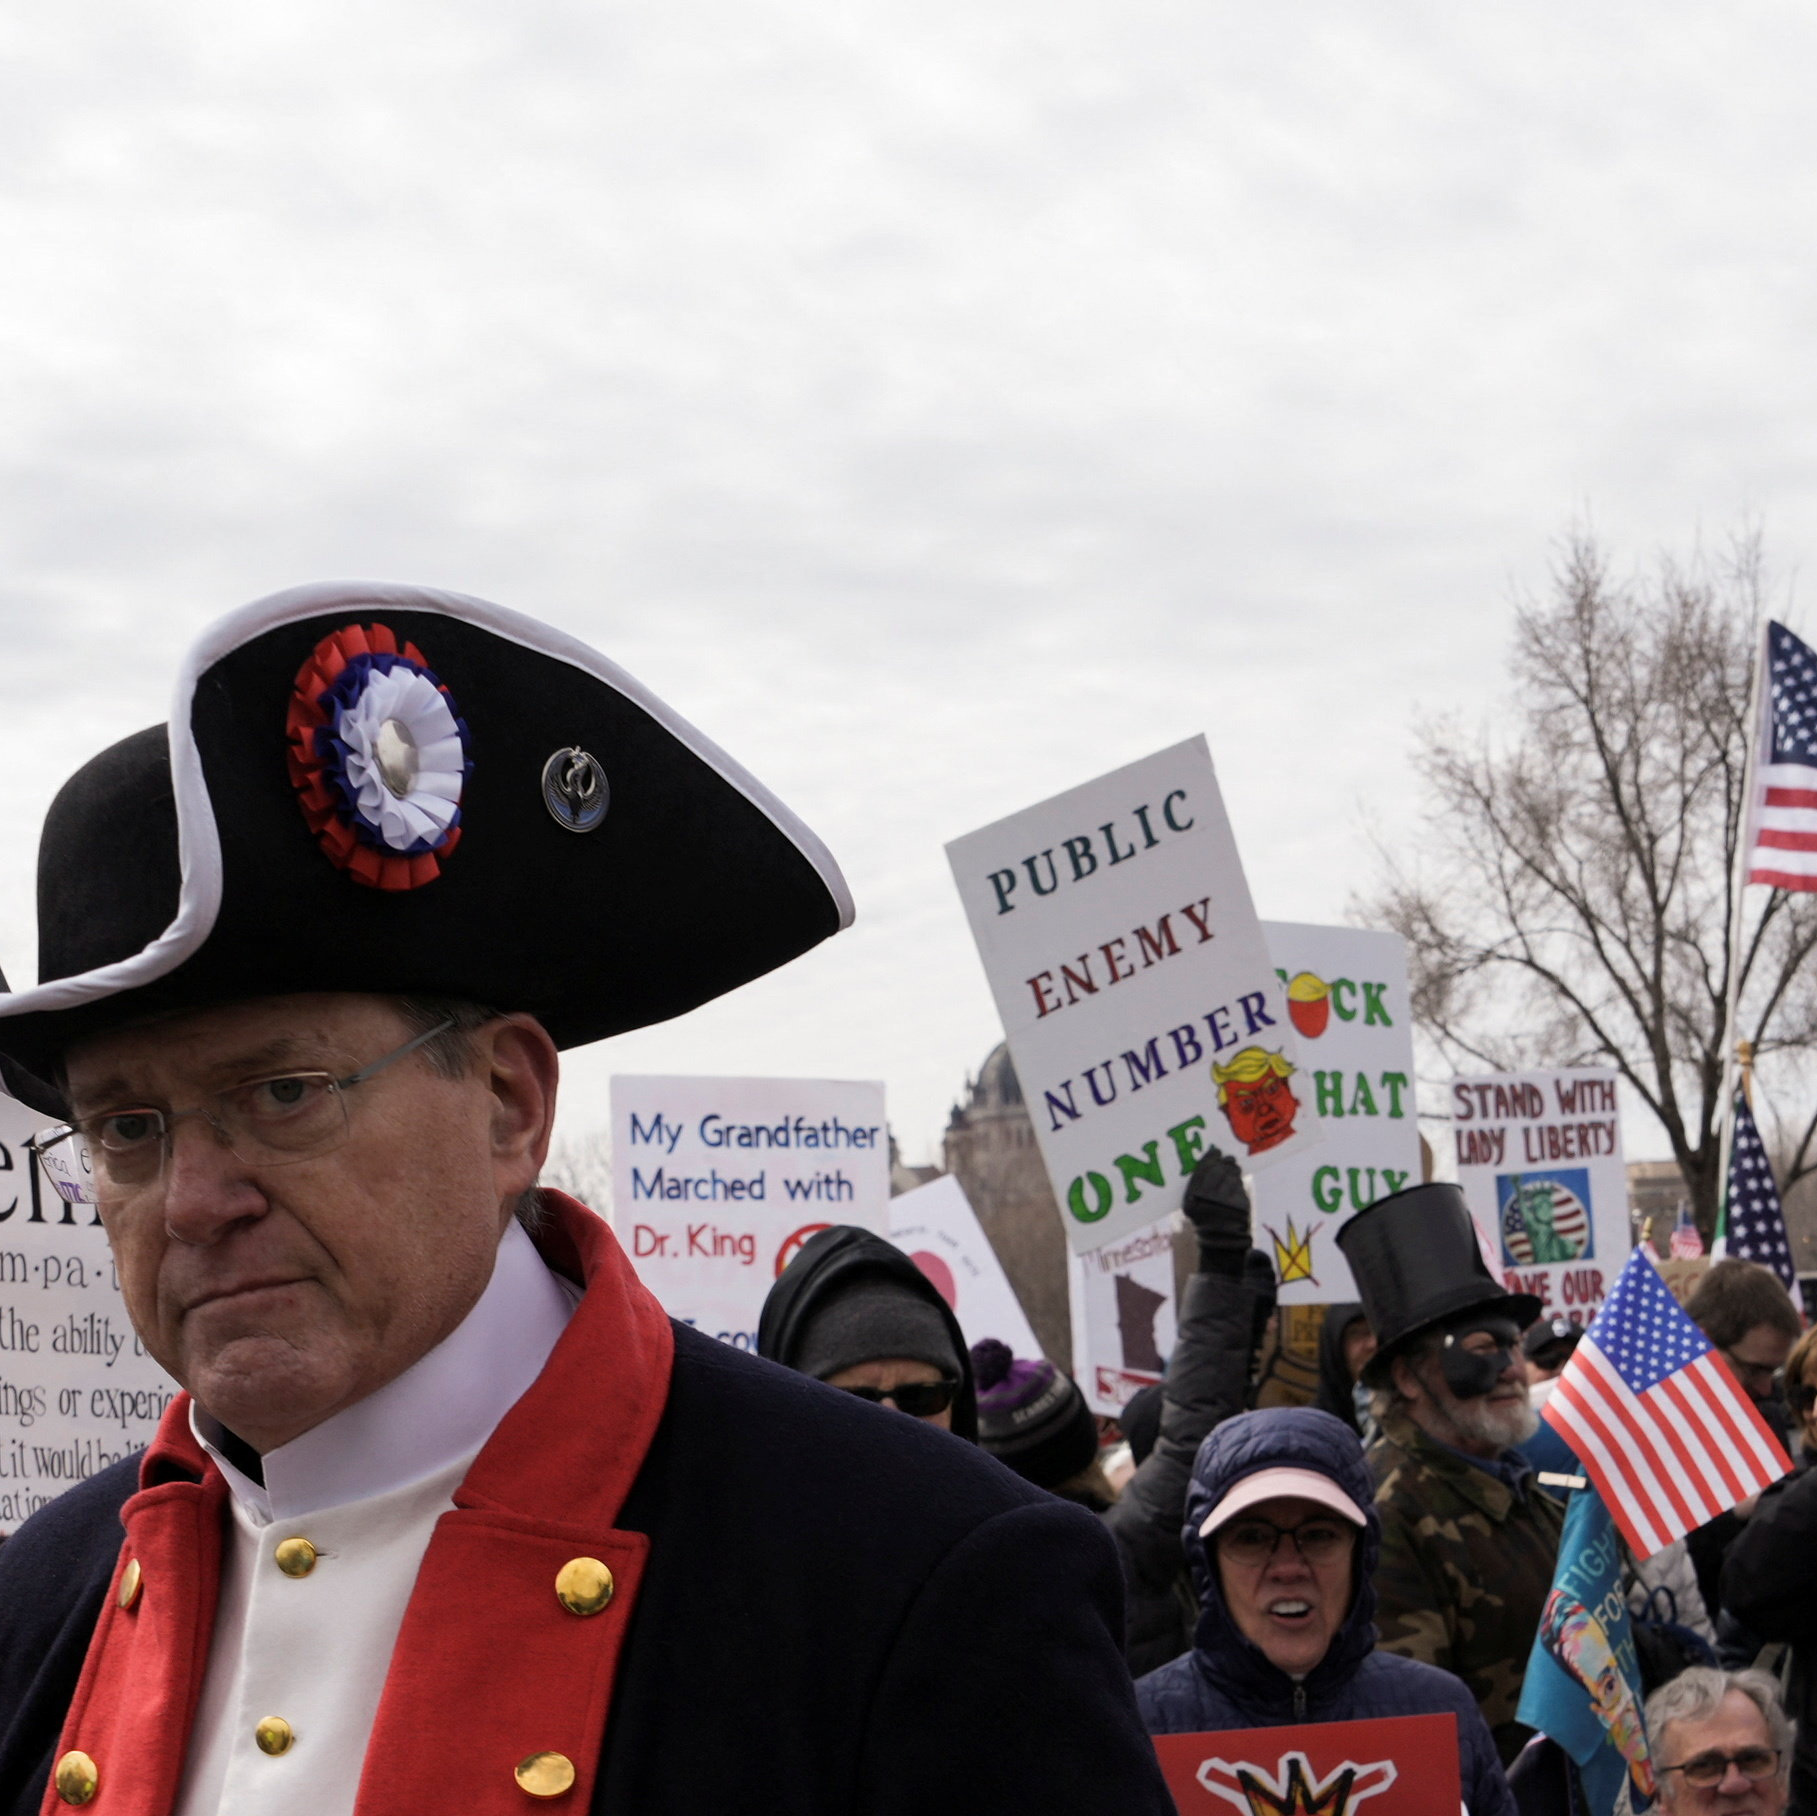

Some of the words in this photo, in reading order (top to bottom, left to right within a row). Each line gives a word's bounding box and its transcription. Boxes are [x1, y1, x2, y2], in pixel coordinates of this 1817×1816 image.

[986, 789, 1196, 916] PUBLIC
[1025, 897, 1218, 1020] ENEMY
[1042, 989, 1277, 1132] NUMBER
[1454, 1083, 1544, 1121] STAND
[1555, 1078, 1617, 1115] WITH
[629, 1113, 683, 1153] My
[699, 1114, 880, 1150] Grandfather
[1455, 1127, 1506, 1166] LADY
[1523, 1119, 1617, 1163] LIBERTY
[632, 1166, 765, 1202] Marched
[783, 1171, 854, 1202] with
[1067, 1114, 1211, 1224] ONE
[633, 1224, 680, 1258] Dr.
[687, 1223, 757, 1264] King
[1562, 1268, 1605, 1306] OUR
[52, 1312, 125, 1367] ability
[59, 1388, 82, 1418] or
[11, 1439, 33, 1478] it
[34, 1438, 93, 1479] would
